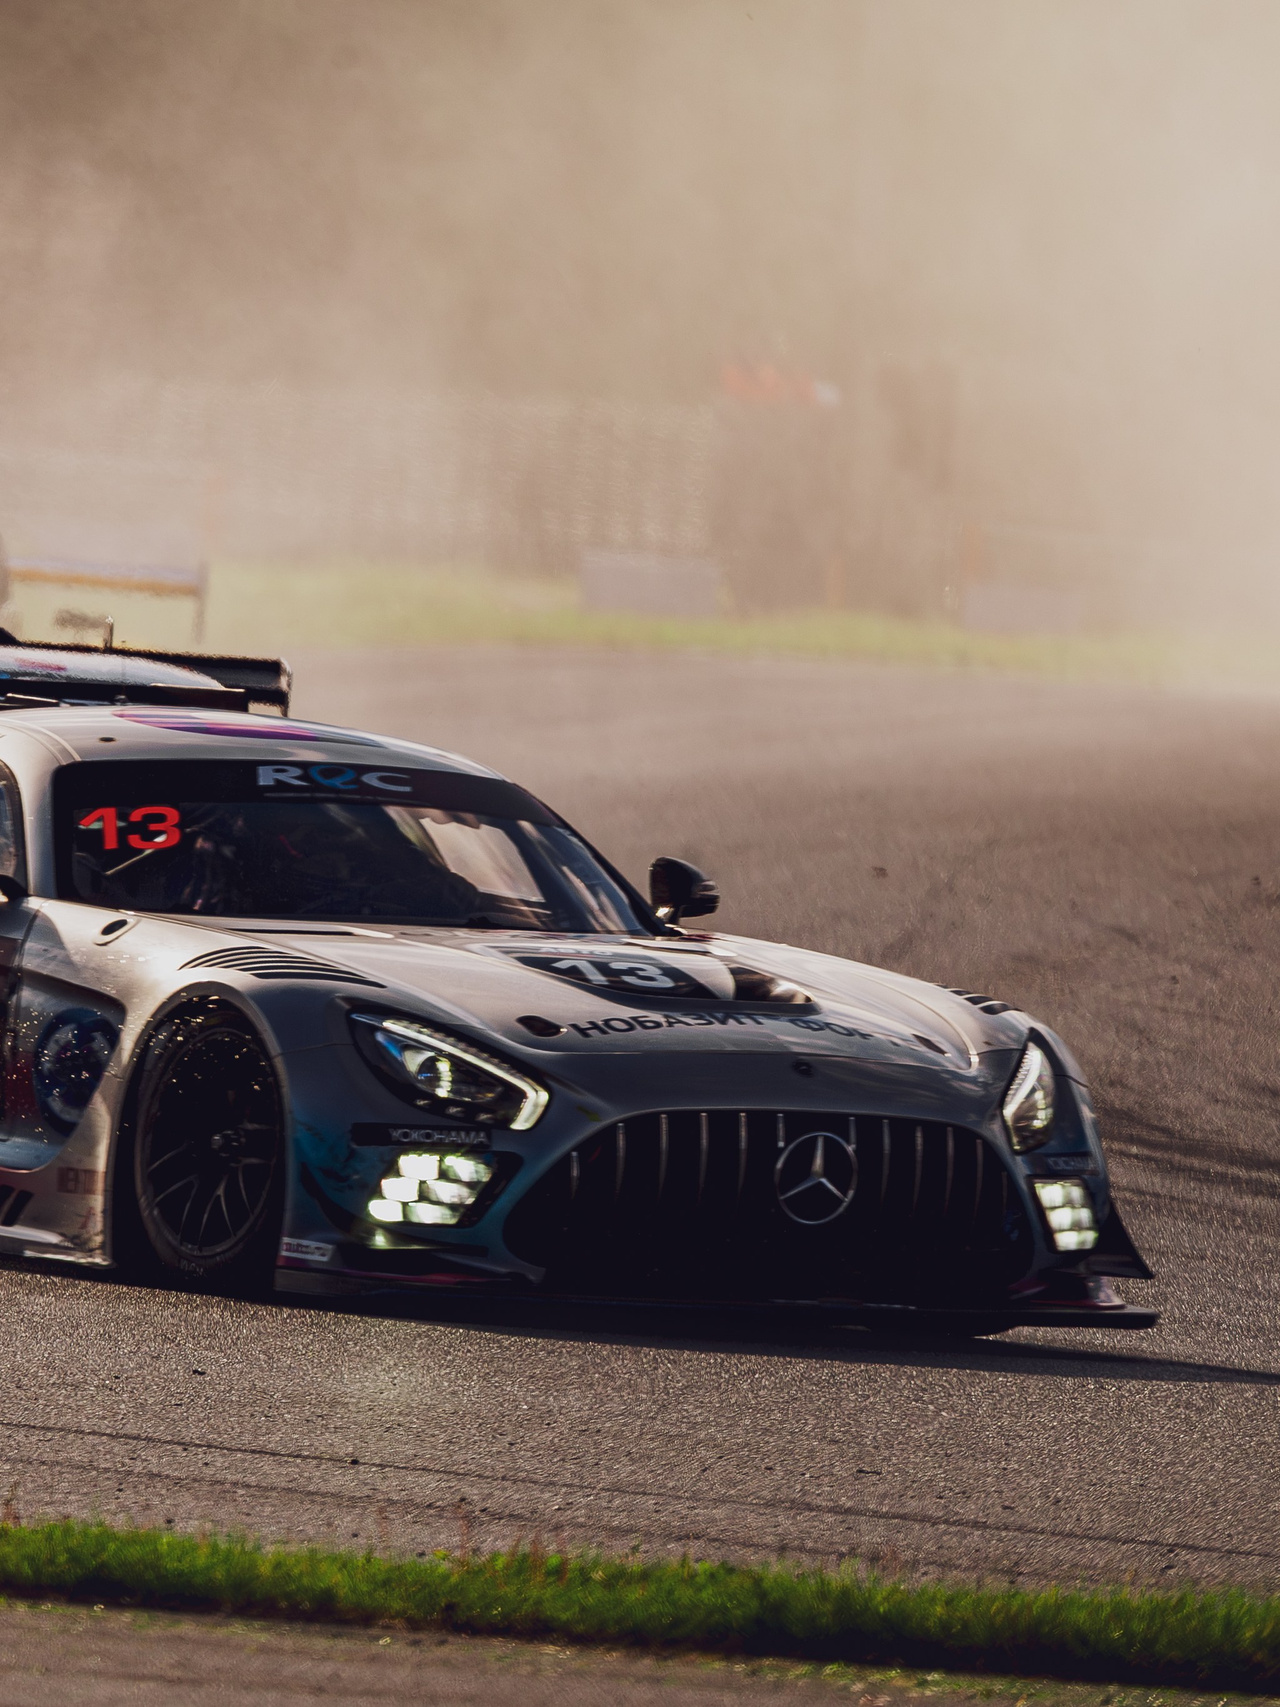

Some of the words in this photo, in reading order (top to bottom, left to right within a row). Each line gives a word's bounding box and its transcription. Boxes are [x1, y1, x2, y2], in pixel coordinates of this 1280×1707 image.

[78, 805, 183, 851] 13
[550, 958, 677, 989] 13
[387, 1127, 492, 1146] YOKOHAMA
